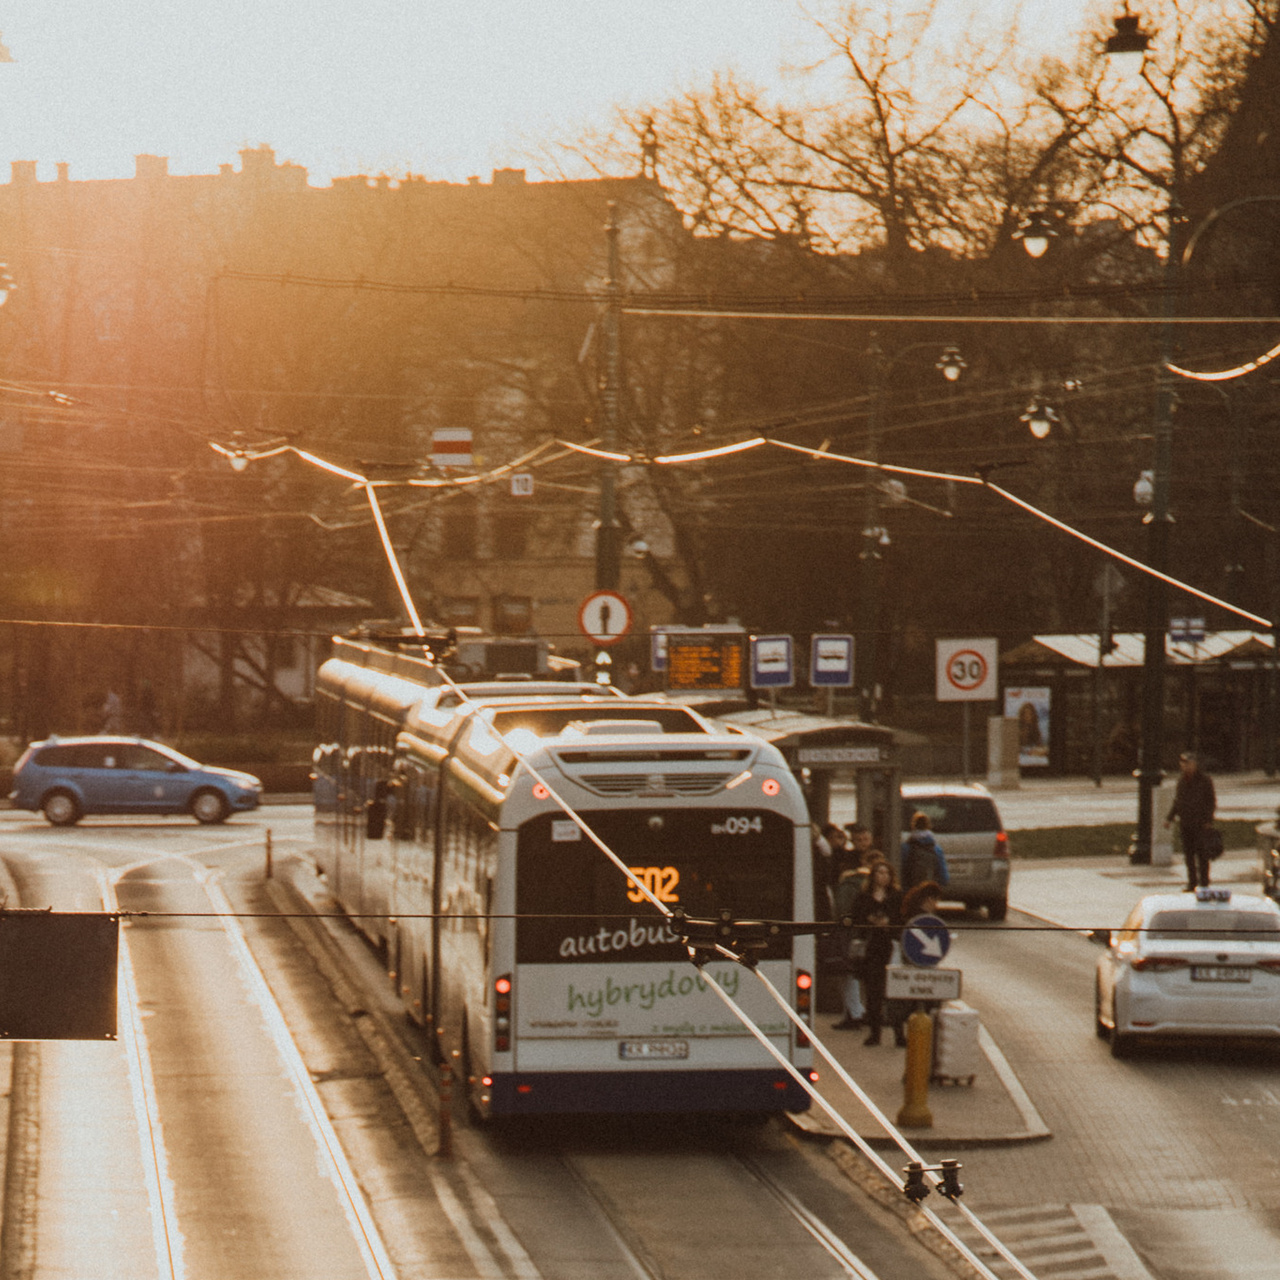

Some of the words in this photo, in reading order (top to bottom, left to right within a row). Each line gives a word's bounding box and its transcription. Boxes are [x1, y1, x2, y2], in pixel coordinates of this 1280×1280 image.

[952, 660, 981, 681] 30
[626, 866, 680, 903] 502
[559, 917, 681, 958] autobus
